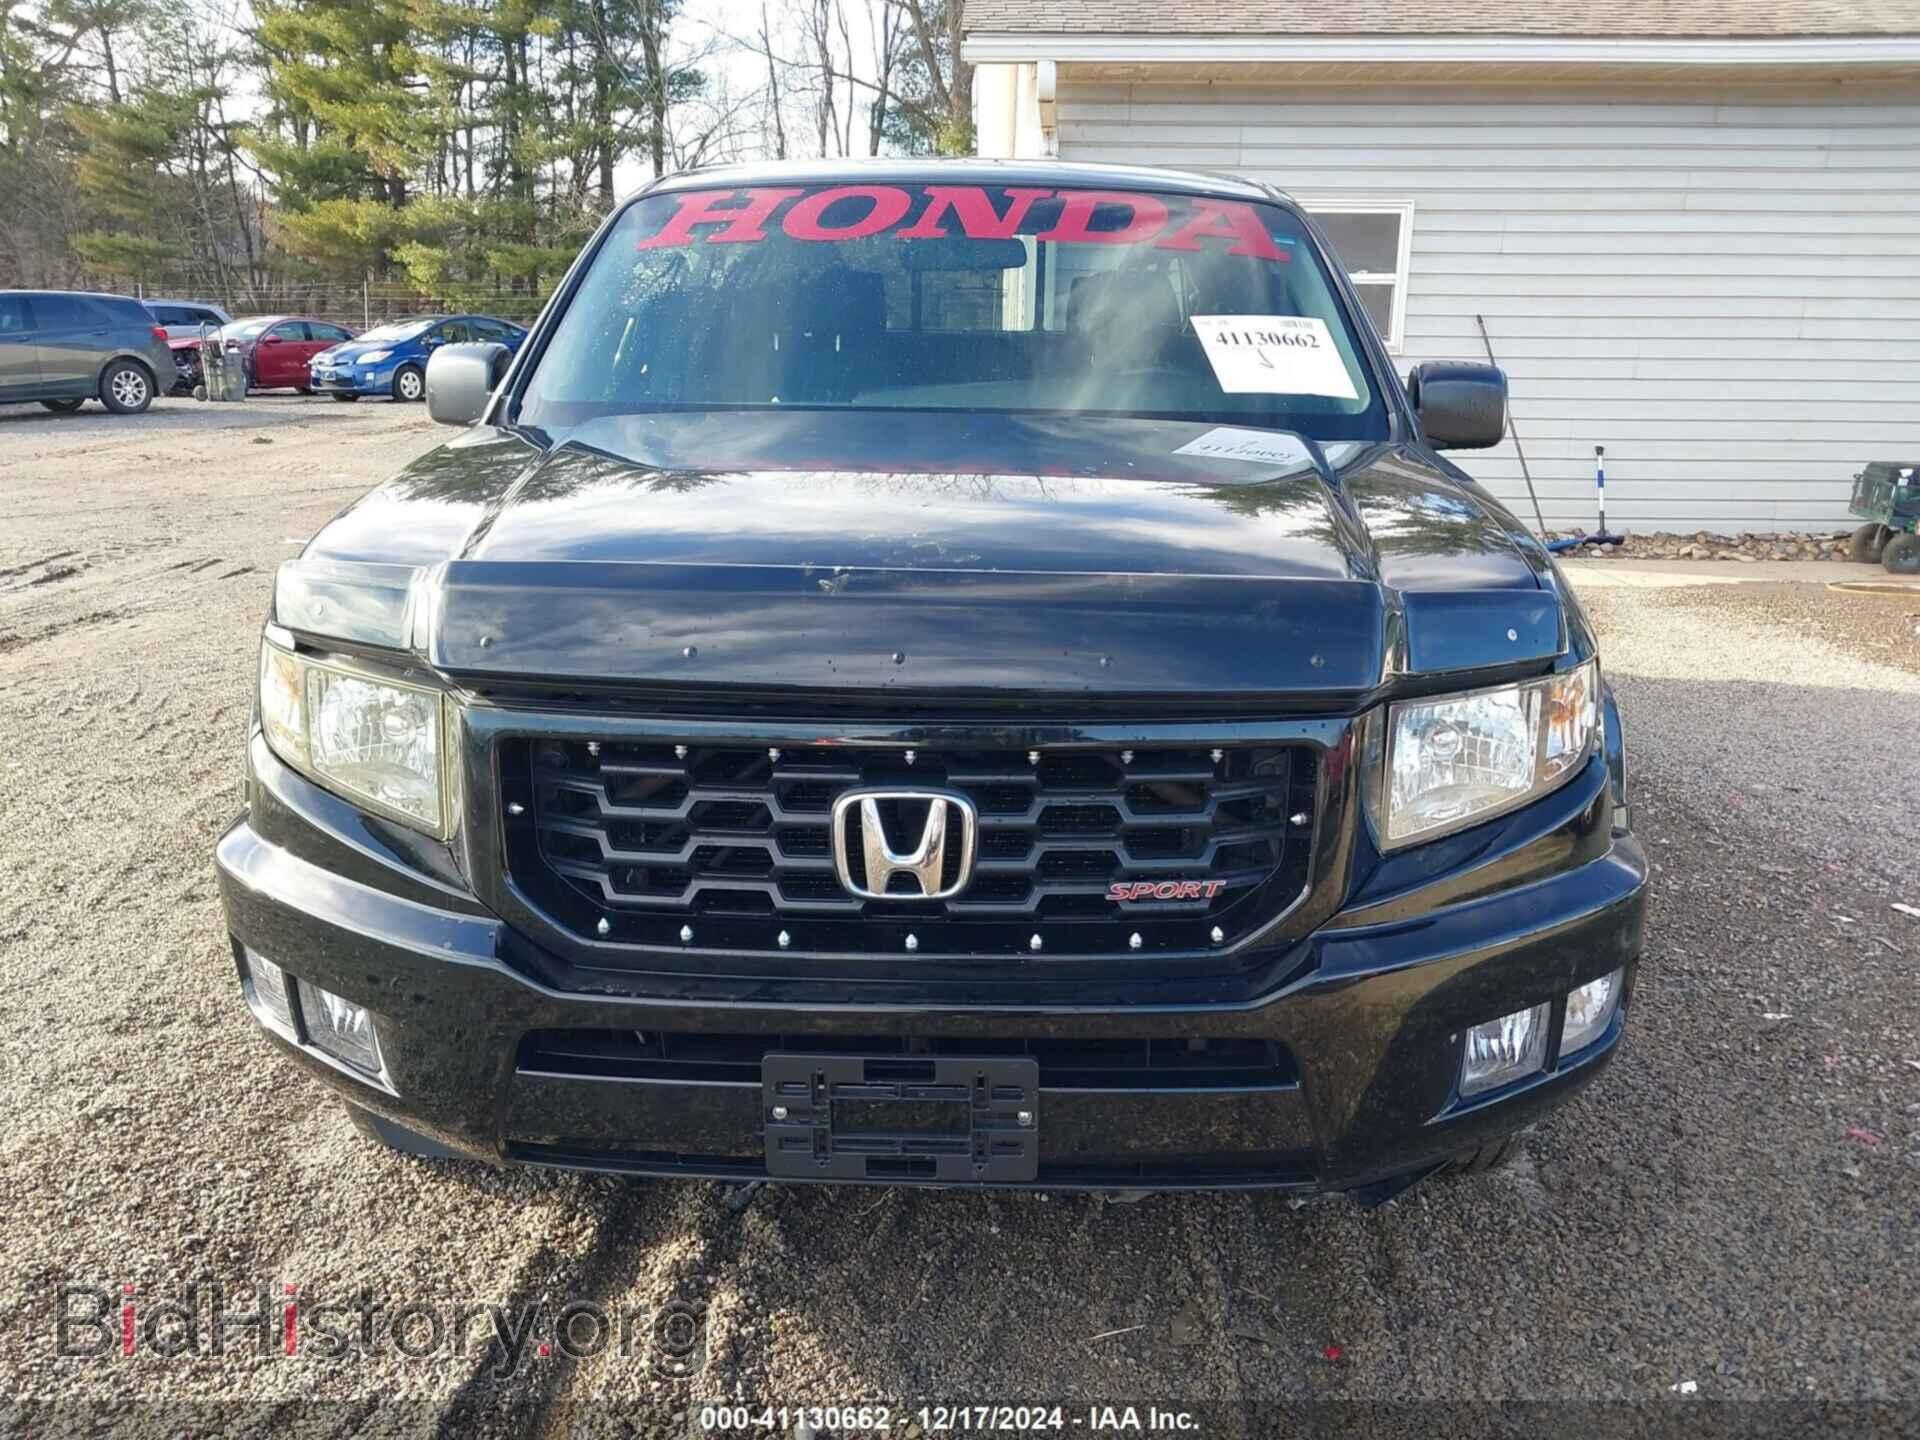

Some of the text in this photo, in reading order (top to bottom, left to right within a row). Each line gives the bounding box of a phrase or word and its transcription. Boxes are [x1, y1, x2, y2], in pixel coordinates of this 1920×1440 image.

[637, 185, 1291, 262] HONDA
[1216, 331, 1320, 348] 41130662
[1105, 879, 1227, 900] SPORT
